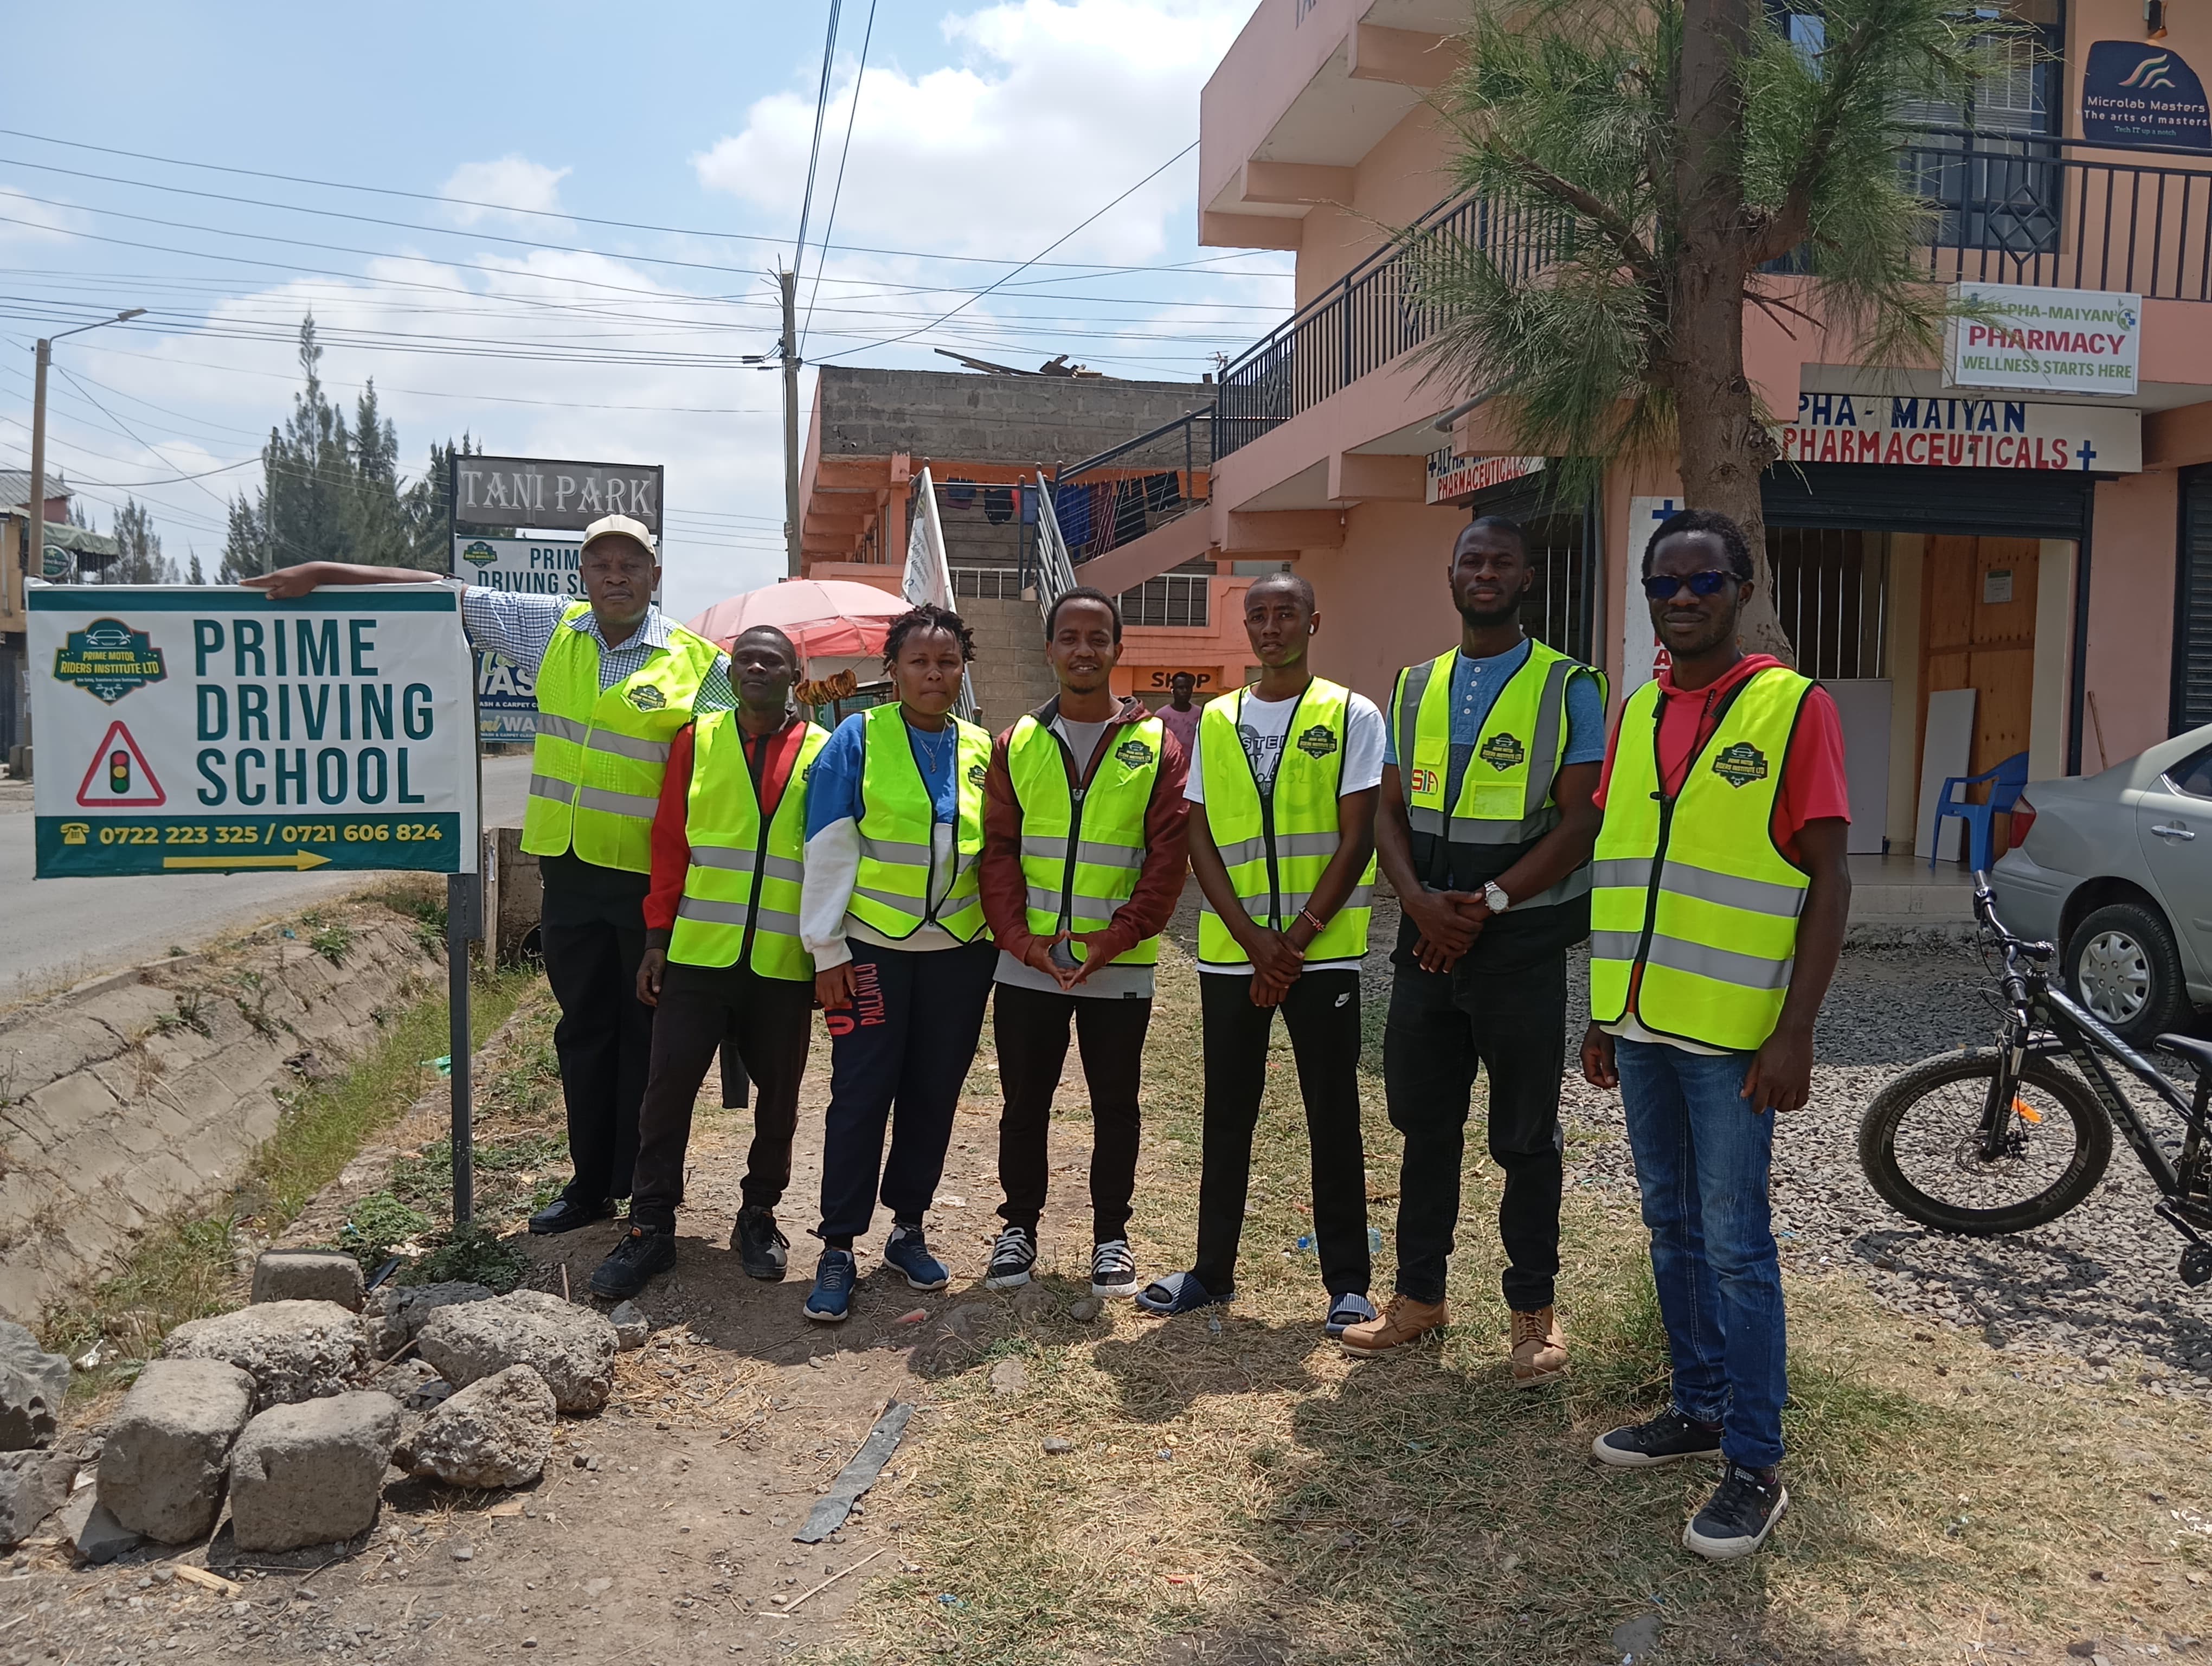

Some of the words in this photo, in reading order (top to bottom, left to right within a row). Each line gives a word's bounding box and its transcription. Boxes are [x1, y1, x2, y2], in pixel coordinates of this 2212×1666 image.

[2085, 110, 2105, 120] The
[2111, 113, 2136, 121] arts
[2140, 114, 2153, 123] of
[2158, 116, 2208, 126] masters
[2087, 96, 2145, 109] Microlab
[2150, 100, 2206, 113] Masters
[1969, 325, 2126, 355] PHARMACY
[1963, 355, 2040, 373] WELLNESS
[2043, 360, 2094, 376] STARTS
[2098, 364, 2132, 379] HERE
[1891, 397, 2025, 433] MAIYAN
[1782, 427, 2068, 469] PHARMACEUTICALS
[1438, 457, 1526, 501] PHARMACEUTICALS
[460, 470, 545, 511] TANI
[554, 476, 654, 516] PARK
[530, 548, 579, 571] PRIM
[478, 570, 559, 595] DRIVING
[82, 651, 107, 661] PRIME
[108, 651, 134, 662] MOTOR
[194, 618, 378, 676] PRIME
[60, 661, 92, 673] RIDERS
[94, 663, 142, 674] INSTITUTE
[143, 661, 159, 674] LTD
[196, 683, 434, 741] DRIVING
[196, 746, 426, 806] SCHOOL
[99, 826, 159, 844] 0722
[165, 826, 208, 843] 223
[215, 825, 259, 843] 325
[263, 823, 276, 845] /
[281, 824, 336, 842] 0721
[343, 824, 389, 841] 606
[396, 823, 442, 841] 824
